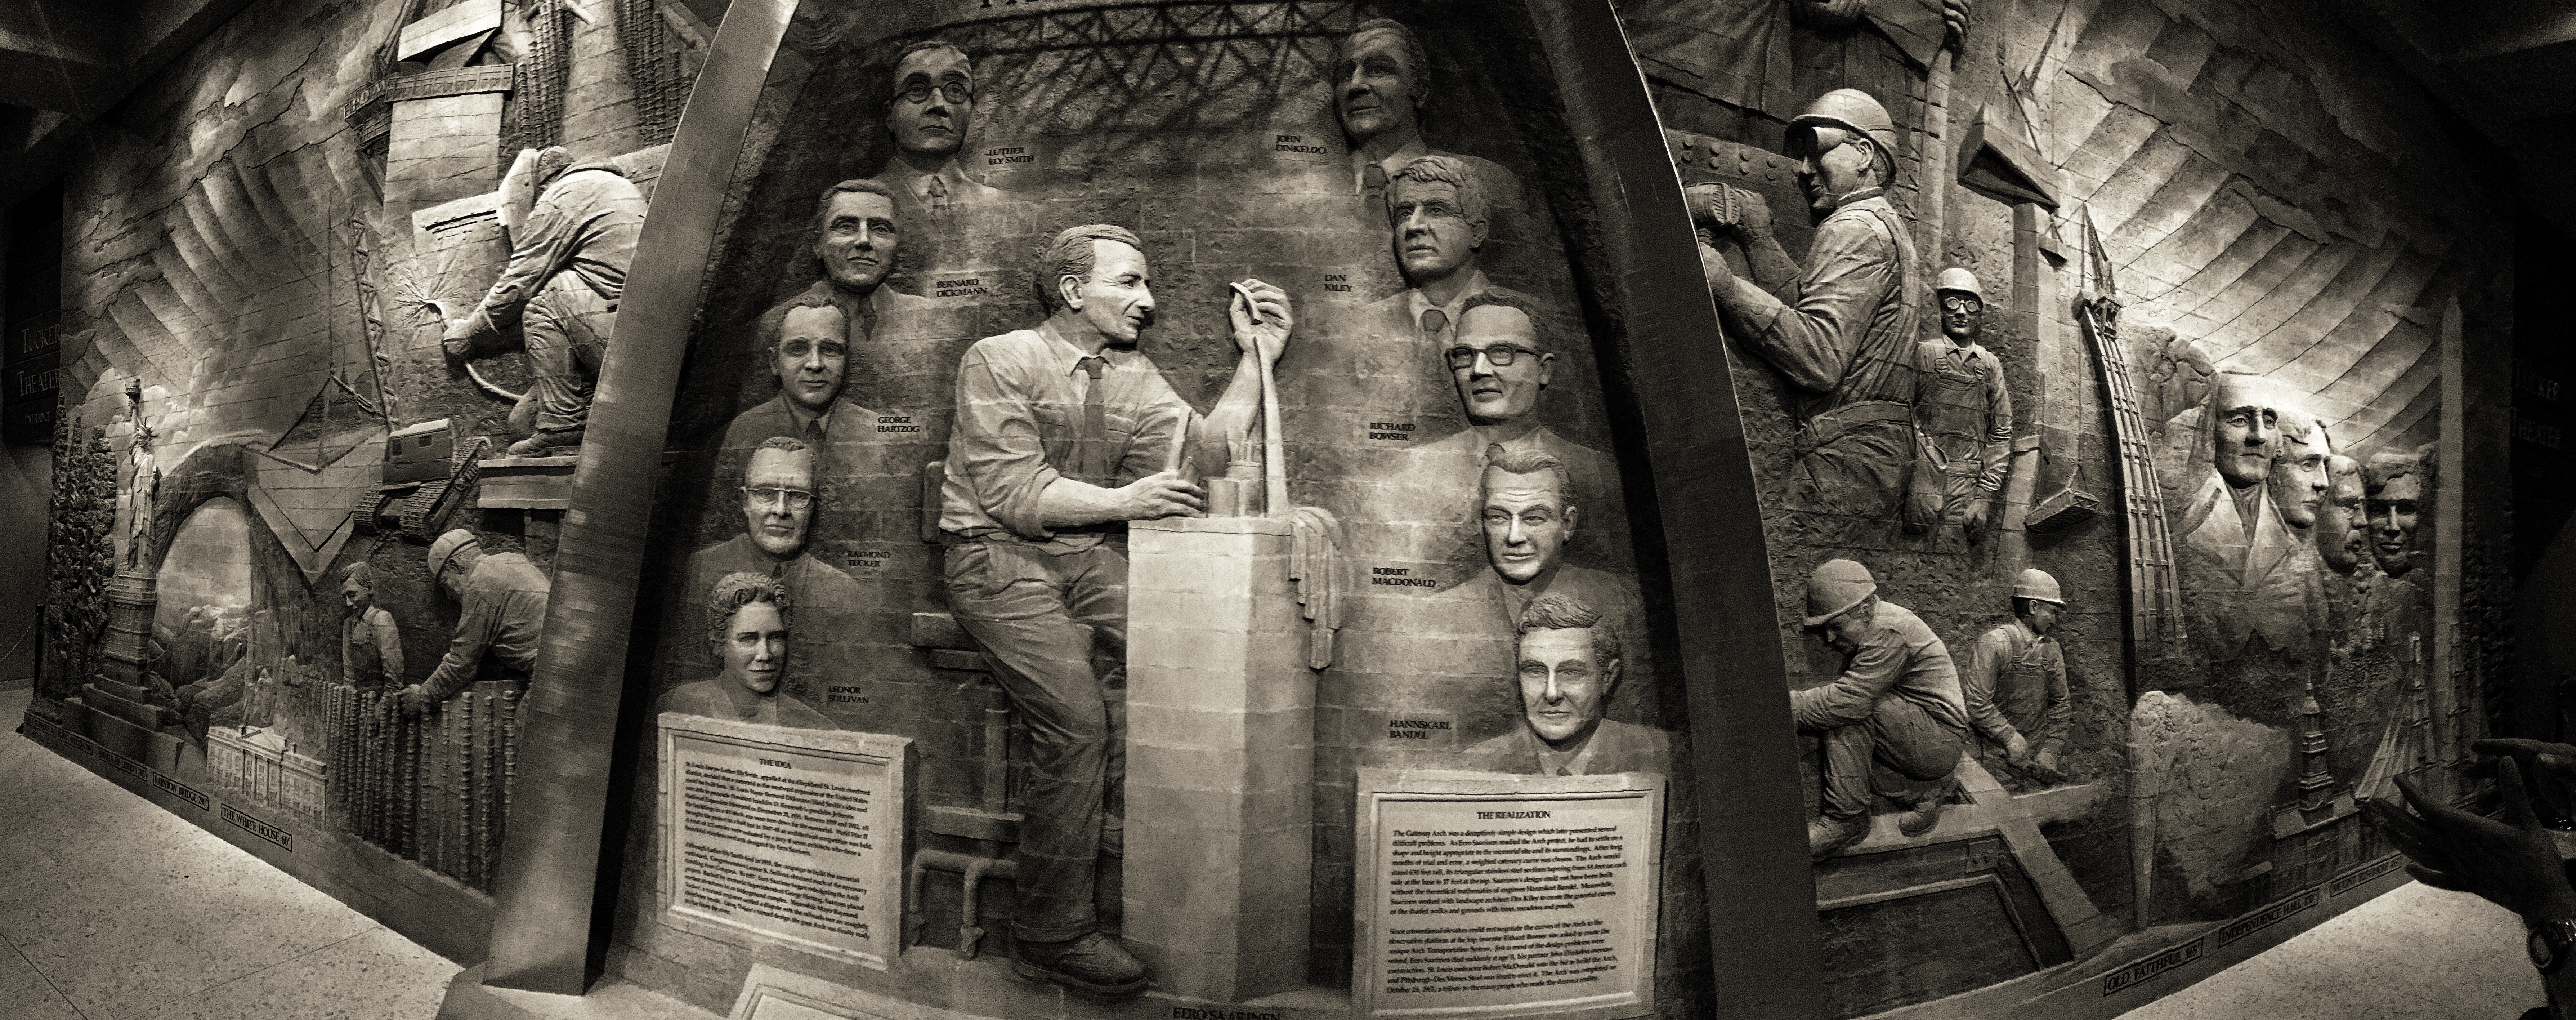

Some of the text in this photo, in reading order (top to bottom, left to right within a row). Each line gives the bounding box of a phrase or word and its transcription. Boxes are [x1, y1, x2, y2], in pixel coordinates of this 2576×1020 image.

[988, 147, 1024, 156] LUTHER
[1276, 145, 1326, 154] DINKELOO
[936, 280, 979, 288] BERNARD
[1325, 284, 1353, 292] KILEY
[936, 288, 987, 297] DICKMANN
[22, 324, 60, 353] TUCKER
[17, 369, 59, 396] THEATER
[1370, 423, 1416, 431] RICHARD
[1372, 578, 1436, 587] MACDONALD
[828, 695, 869, 704] SULLIVAN
[1390, 721, 1451, 730] HANNSKARL
[775, 760, 791, 769] IDEA
[155, 775, 177, 793] RAINBOW
[179, 786, 197, 803] BRIDGE
[223, 807, 235, 821] THE
[237, 814, 256, 832] WHITE
[259, 822, 279, 842] HOUSE
[2222, 908, 2281, 943] INDEPENDENCE
[2283, 899, 2301, 916] HALL
[2108, 972, 2130, 990] OLD
[2186, 942, 2200, 959] 165'
[1174, 1007, 1206, 1020] EERO
